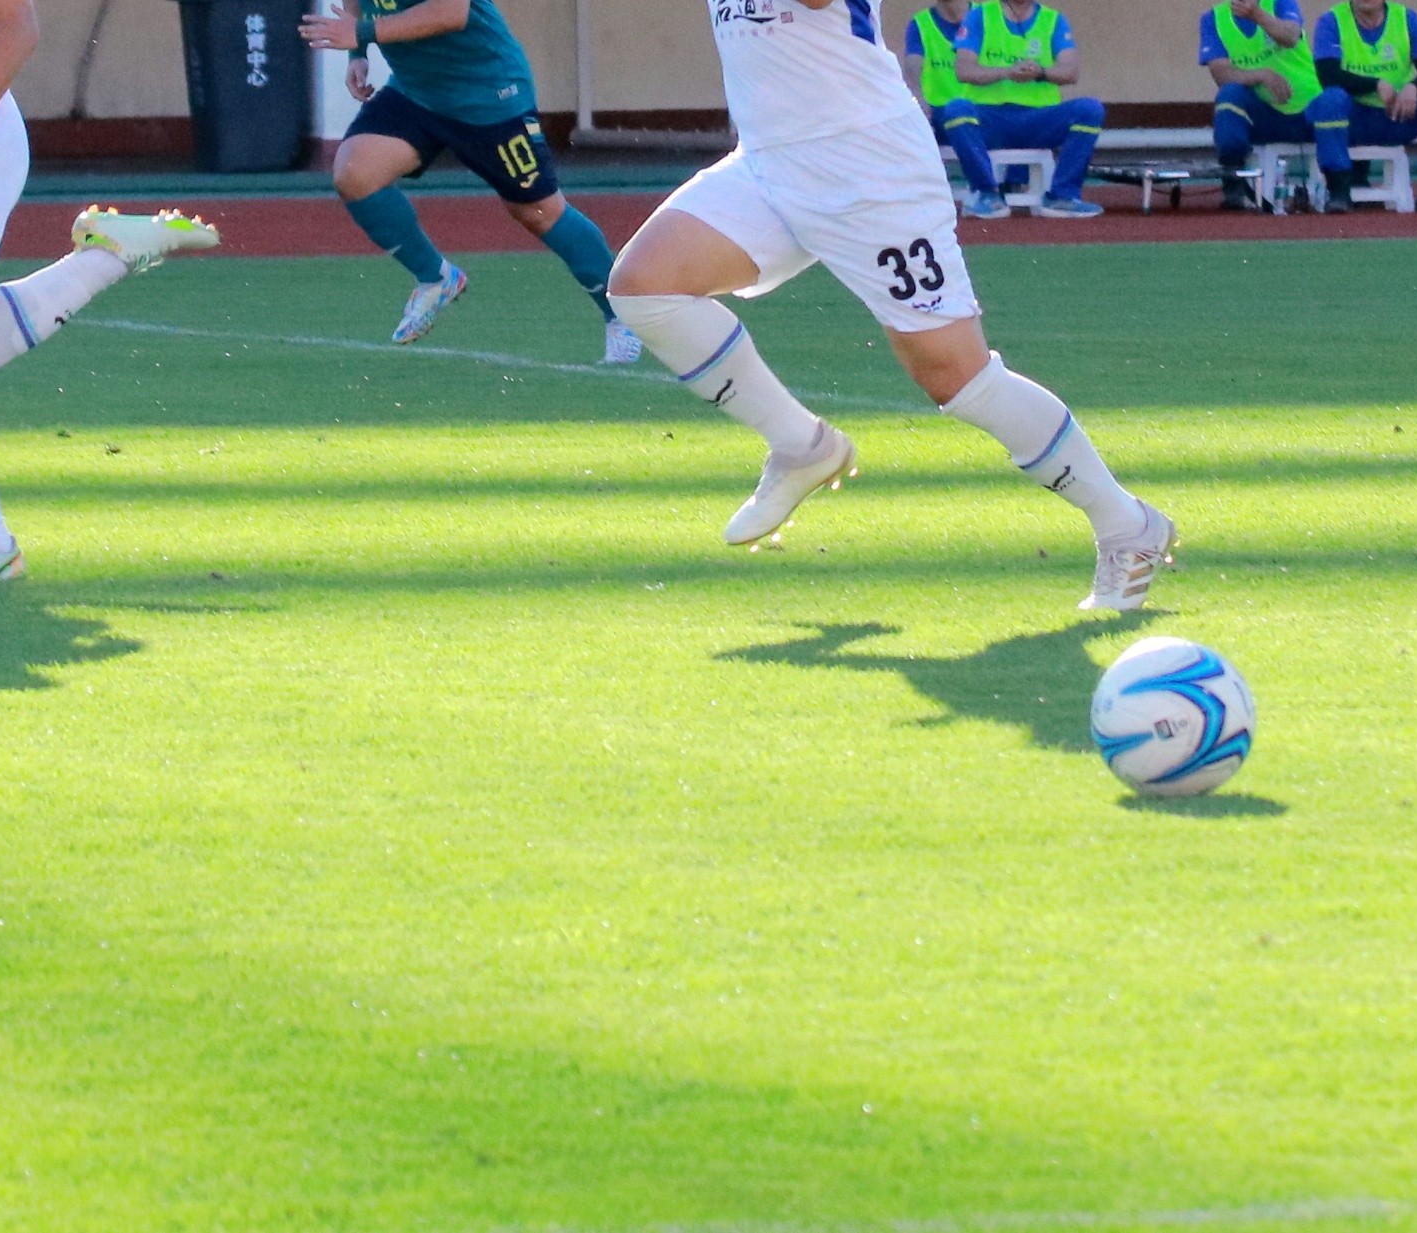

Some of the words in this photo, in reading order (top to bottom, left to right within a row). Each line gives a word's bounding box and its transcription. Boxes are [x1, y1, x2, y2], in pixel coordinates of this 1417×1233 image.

[244, 13, 268, 88] 体育中心
[497, 133, 537, 178] 10
[877, 237, 945, 301] 33
